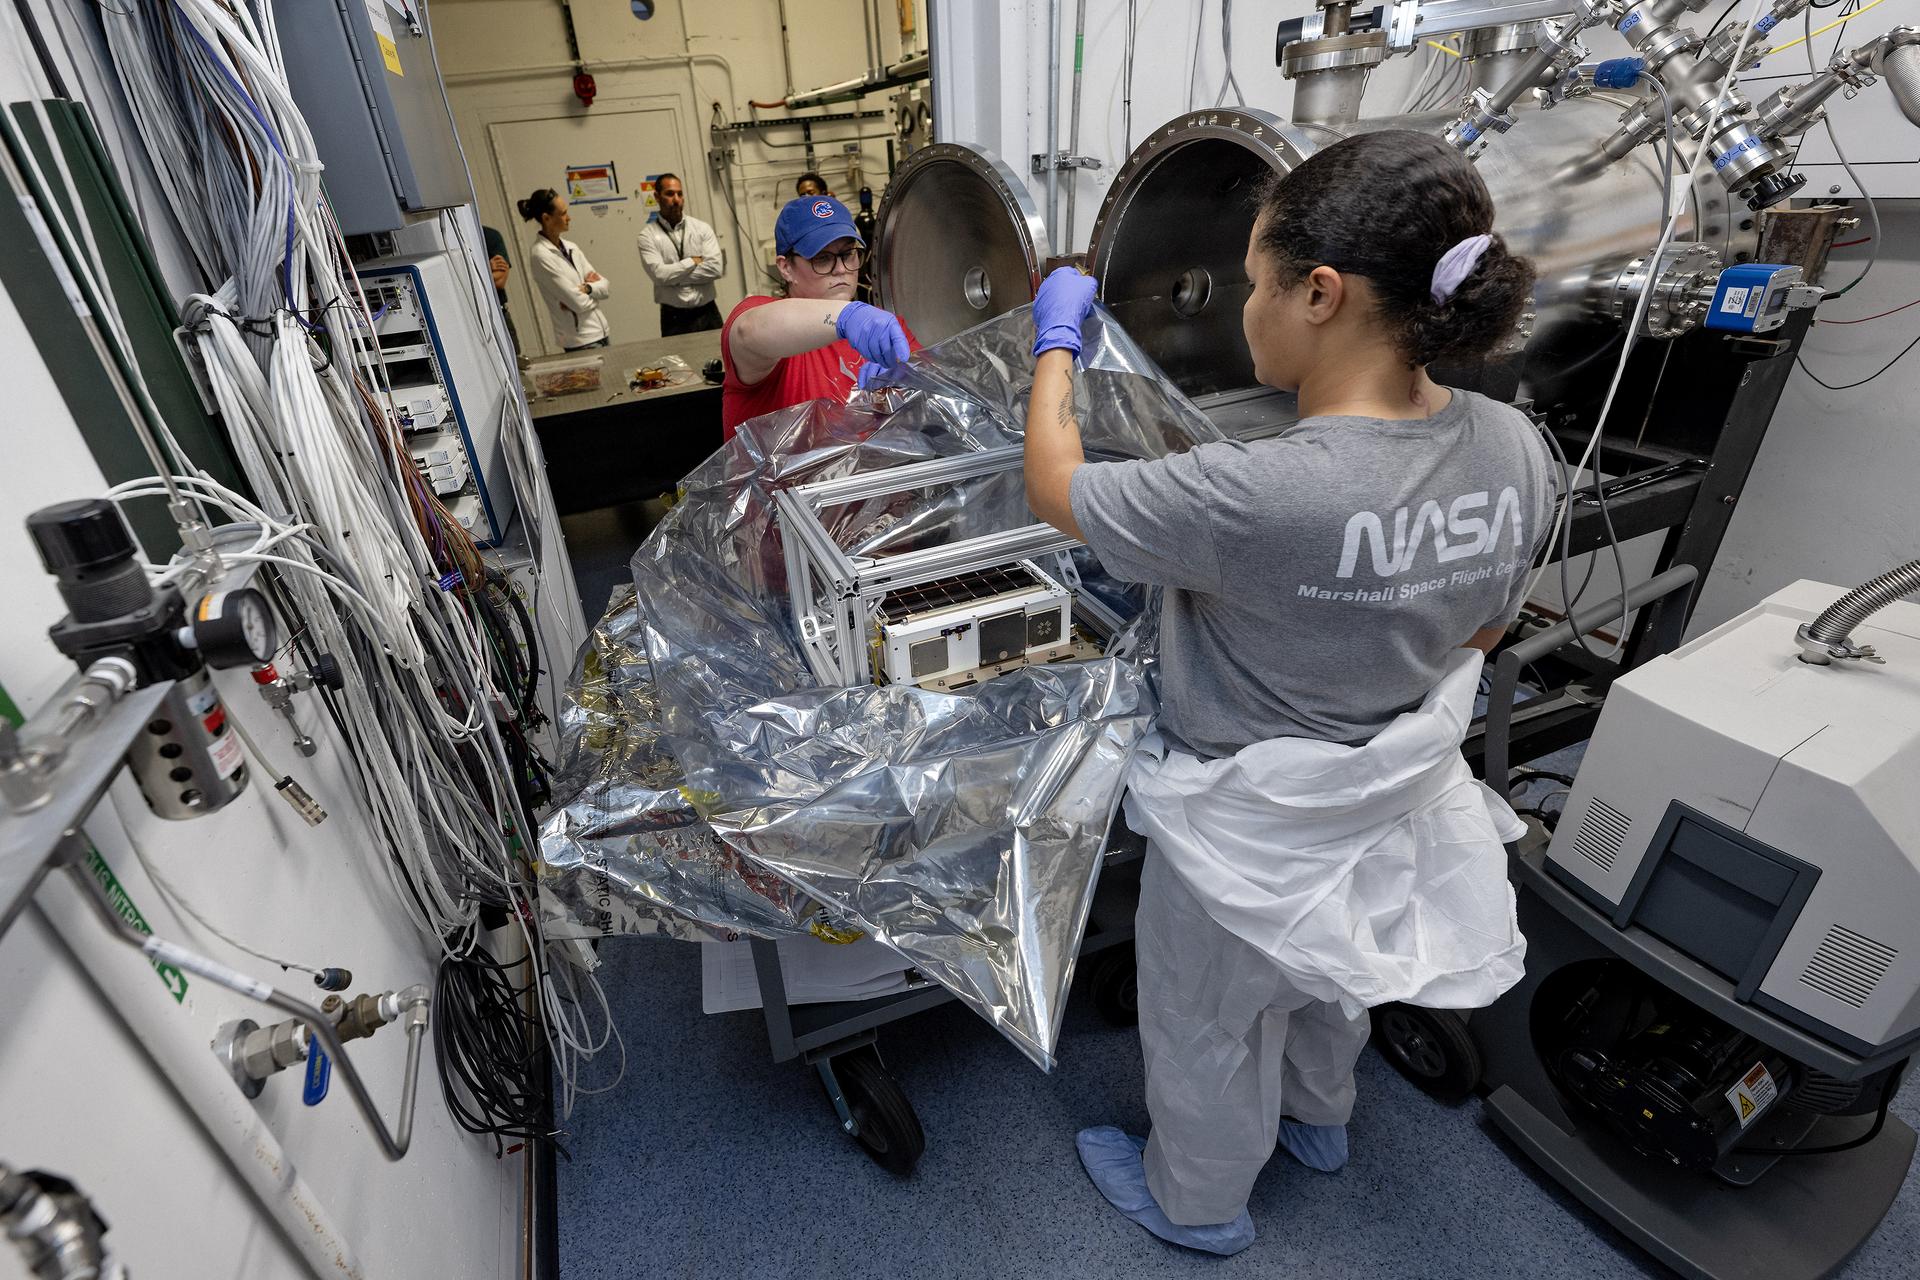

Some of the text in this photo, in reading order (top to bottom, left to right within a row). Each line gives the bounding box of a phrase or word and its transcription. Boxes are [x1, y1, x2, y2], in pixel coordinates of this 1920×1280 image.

[1757, 16, 1776, 31] G6
[1335, 486, 1523, 578] NASA
[1297, 583, 1394, 602] Marshall
[1399, 577, 1447, 600] Space
[1450, 564, 1493, 587] Flight
[595, 858, 611, 907] STATIC
